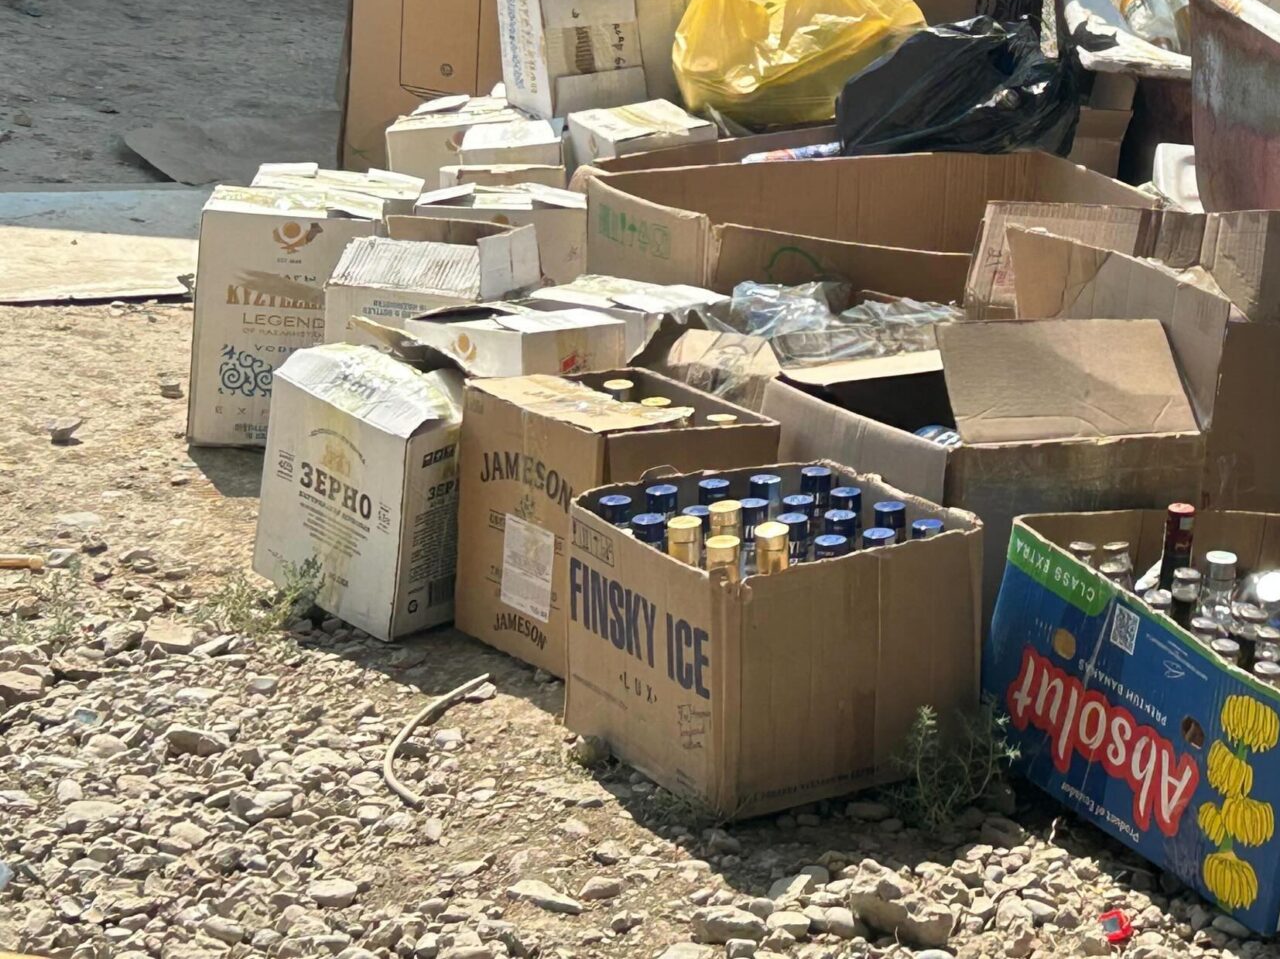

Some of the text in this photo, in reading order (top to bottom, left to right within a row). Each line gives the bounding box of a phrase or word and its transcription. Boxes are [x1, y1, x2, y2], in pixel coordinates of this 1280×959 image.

[299, 460, 373, 521] ЗЕРНО
[480, 451, 574, 514] JAMESON
[1016, 538, 1096, 603] CLASS EXTRA
[493, 612, 548, 651] JAMESON
[569, 556, 657, 669] FINSKY
[666, 612, 711, 700] ICE
[1012, 654, 1196, 824] Absolut
